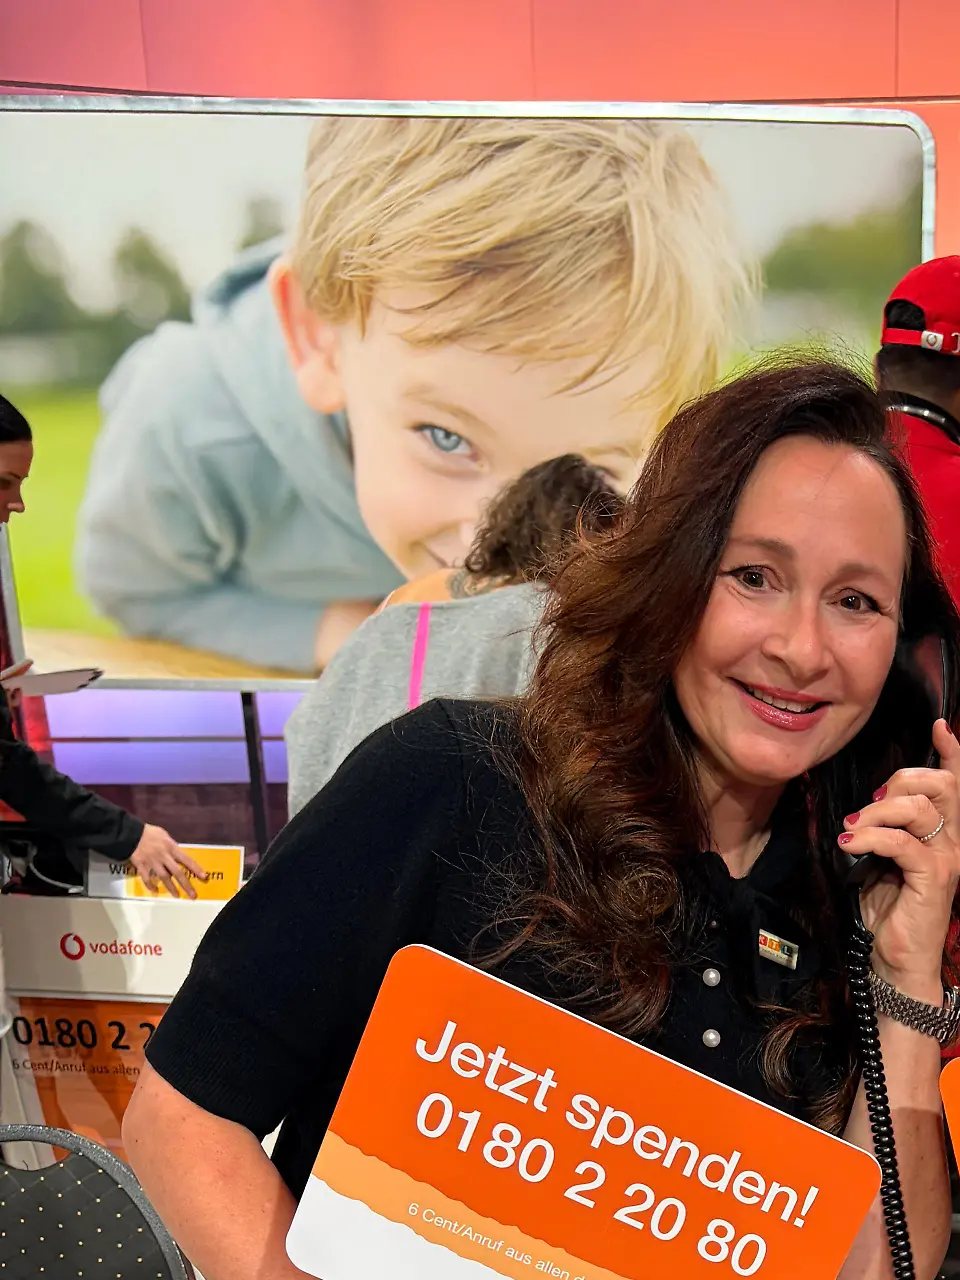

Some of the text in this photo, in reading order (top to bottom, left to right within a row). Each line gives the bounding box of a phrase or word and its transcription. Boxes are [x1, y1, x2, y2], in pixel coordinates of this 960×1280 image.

[89, 939, 163, 956] vodafone
[12, 1016, 98, 1049] 0180
[108, 1020, 130, 1050] 2
[22, 1059, 86, 1073] Cent/Anruf
[91, 1063, 109, 1074] aus
[113, 1064, 141, 1076] allen
[415, 1020, 820, 1229] Jetzt spenden!
[416, 1092, 768, 1277] 0180 2 20 80
[407, 1202, 418, 1216] 6
[421, 1208, 505, 1253] Cent/Anruf
[504, 1245, 533, 1266] aus
